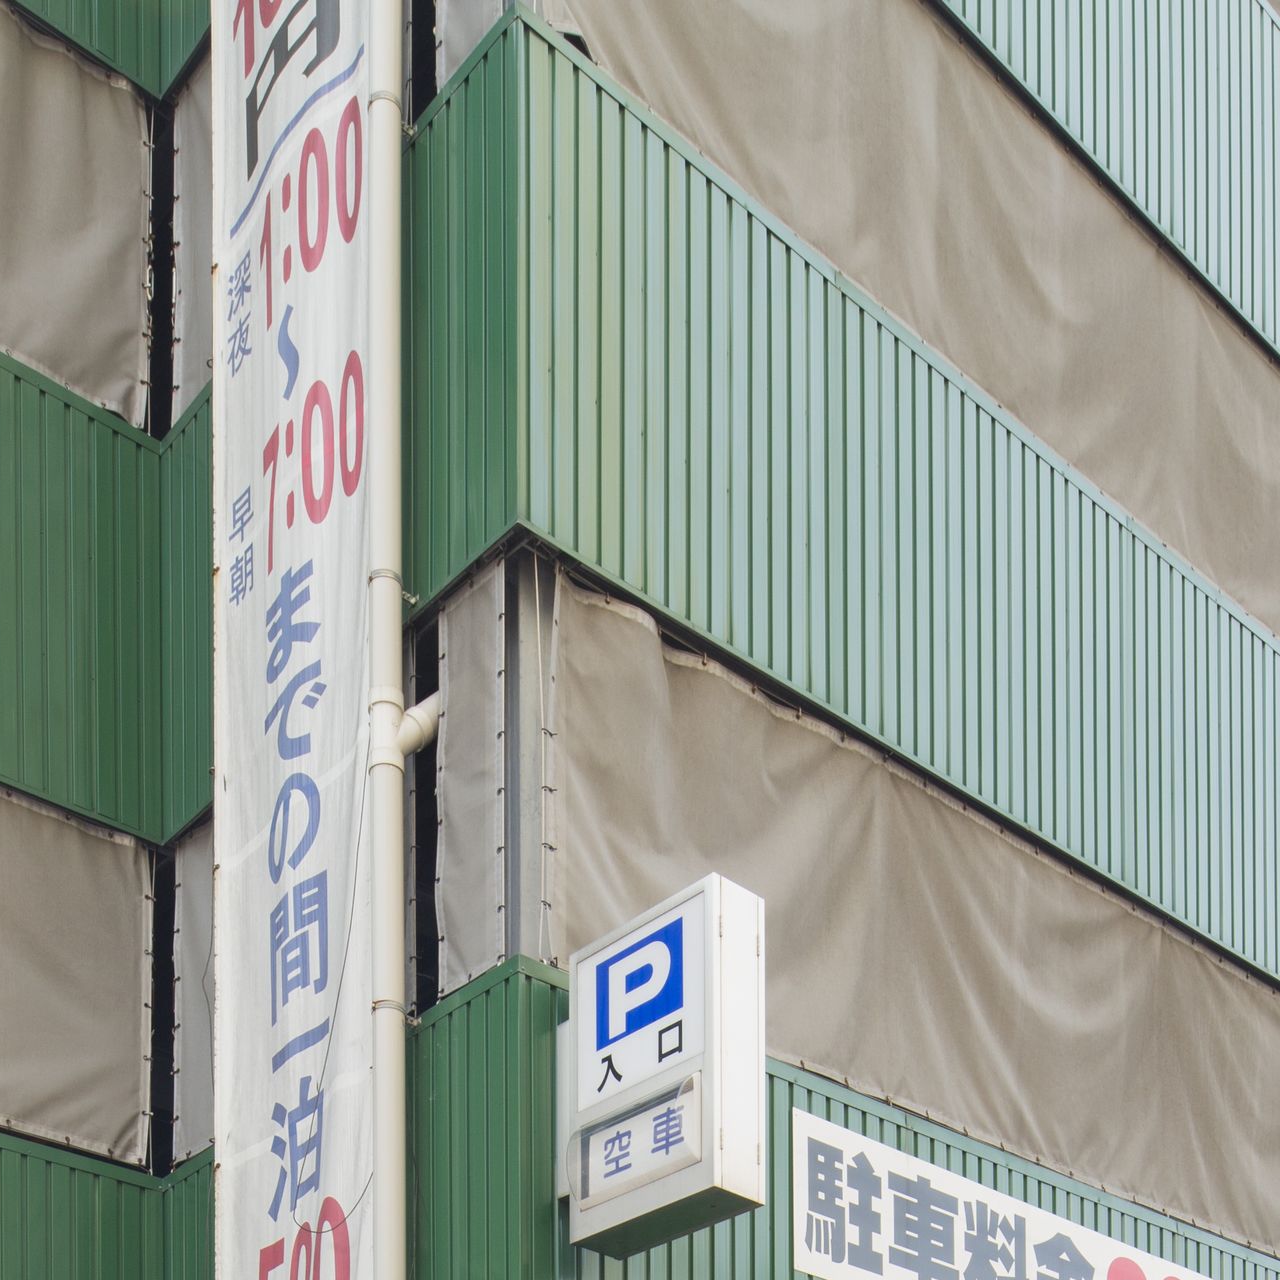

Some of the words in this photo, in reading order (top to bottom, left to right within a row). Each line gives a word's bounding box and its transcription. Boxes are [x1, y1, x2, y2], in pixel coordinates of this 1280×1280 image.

[226, 248, 253, 378] 深夜
[228, 485, 255, 607] 早朝
[608, 940, 671, 1040] P
[597, 1019, 683, 1093] 入口
[603, 1105, 685, 1179] 空車
